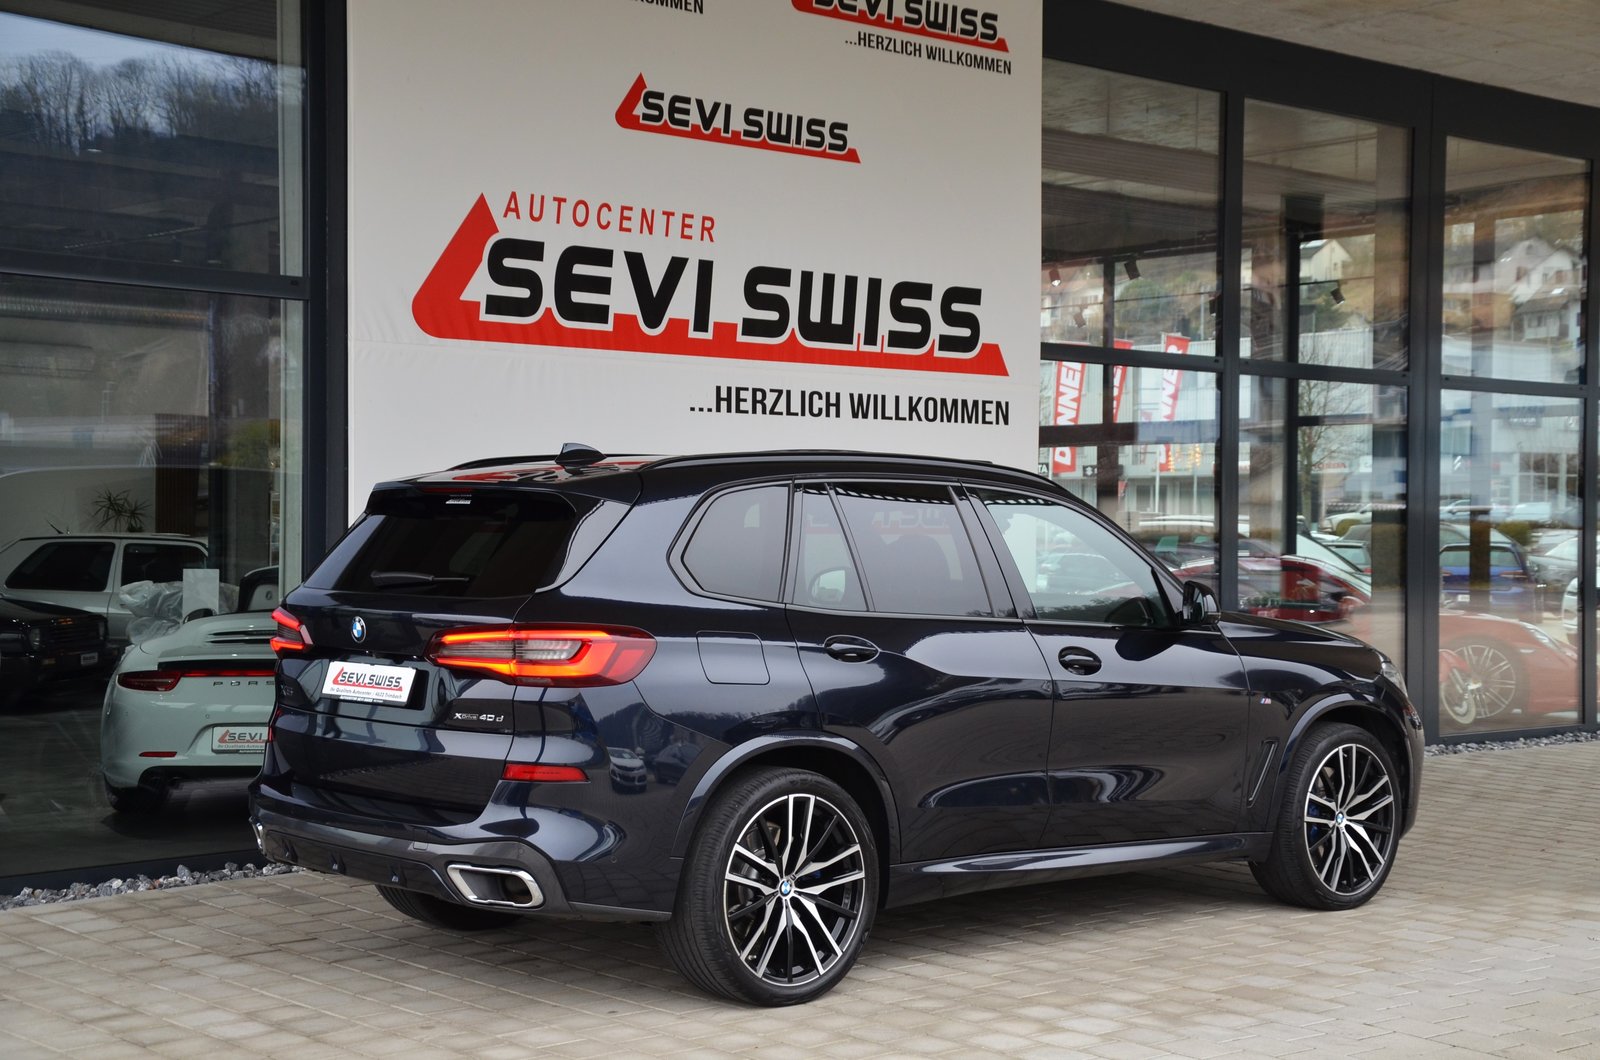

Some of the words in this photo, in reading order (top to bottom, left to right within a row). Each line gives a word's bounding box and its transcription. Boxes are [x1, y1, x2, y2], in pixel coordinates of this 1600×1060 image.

[815, 0, 894, 21] VI
[901, 0, 998, 42] SWISS
[845, 31, 922, 58] ...HERZLICH
[926, 44, 1012, 75] WILLKOMMEN
[641, 90, 732, 135] SEVI
[742, 107, 849, 153] SWISS
[503, 191, 716, 243] AUTOCENTER
[485, 237, 714, 333] SEVI
[741, 265, 982, 354] SWISS
[689, 385, 841, 419] ...HERZLICH
[848, 392, 1010, 426] WILLKOMMEN
[1054, 361, 1082, 466] DNNE
[339, 671, 367, 685] SEVI
[367, 674, 402, 688] SWISS
[228, 732, 263, 741] SEVI
